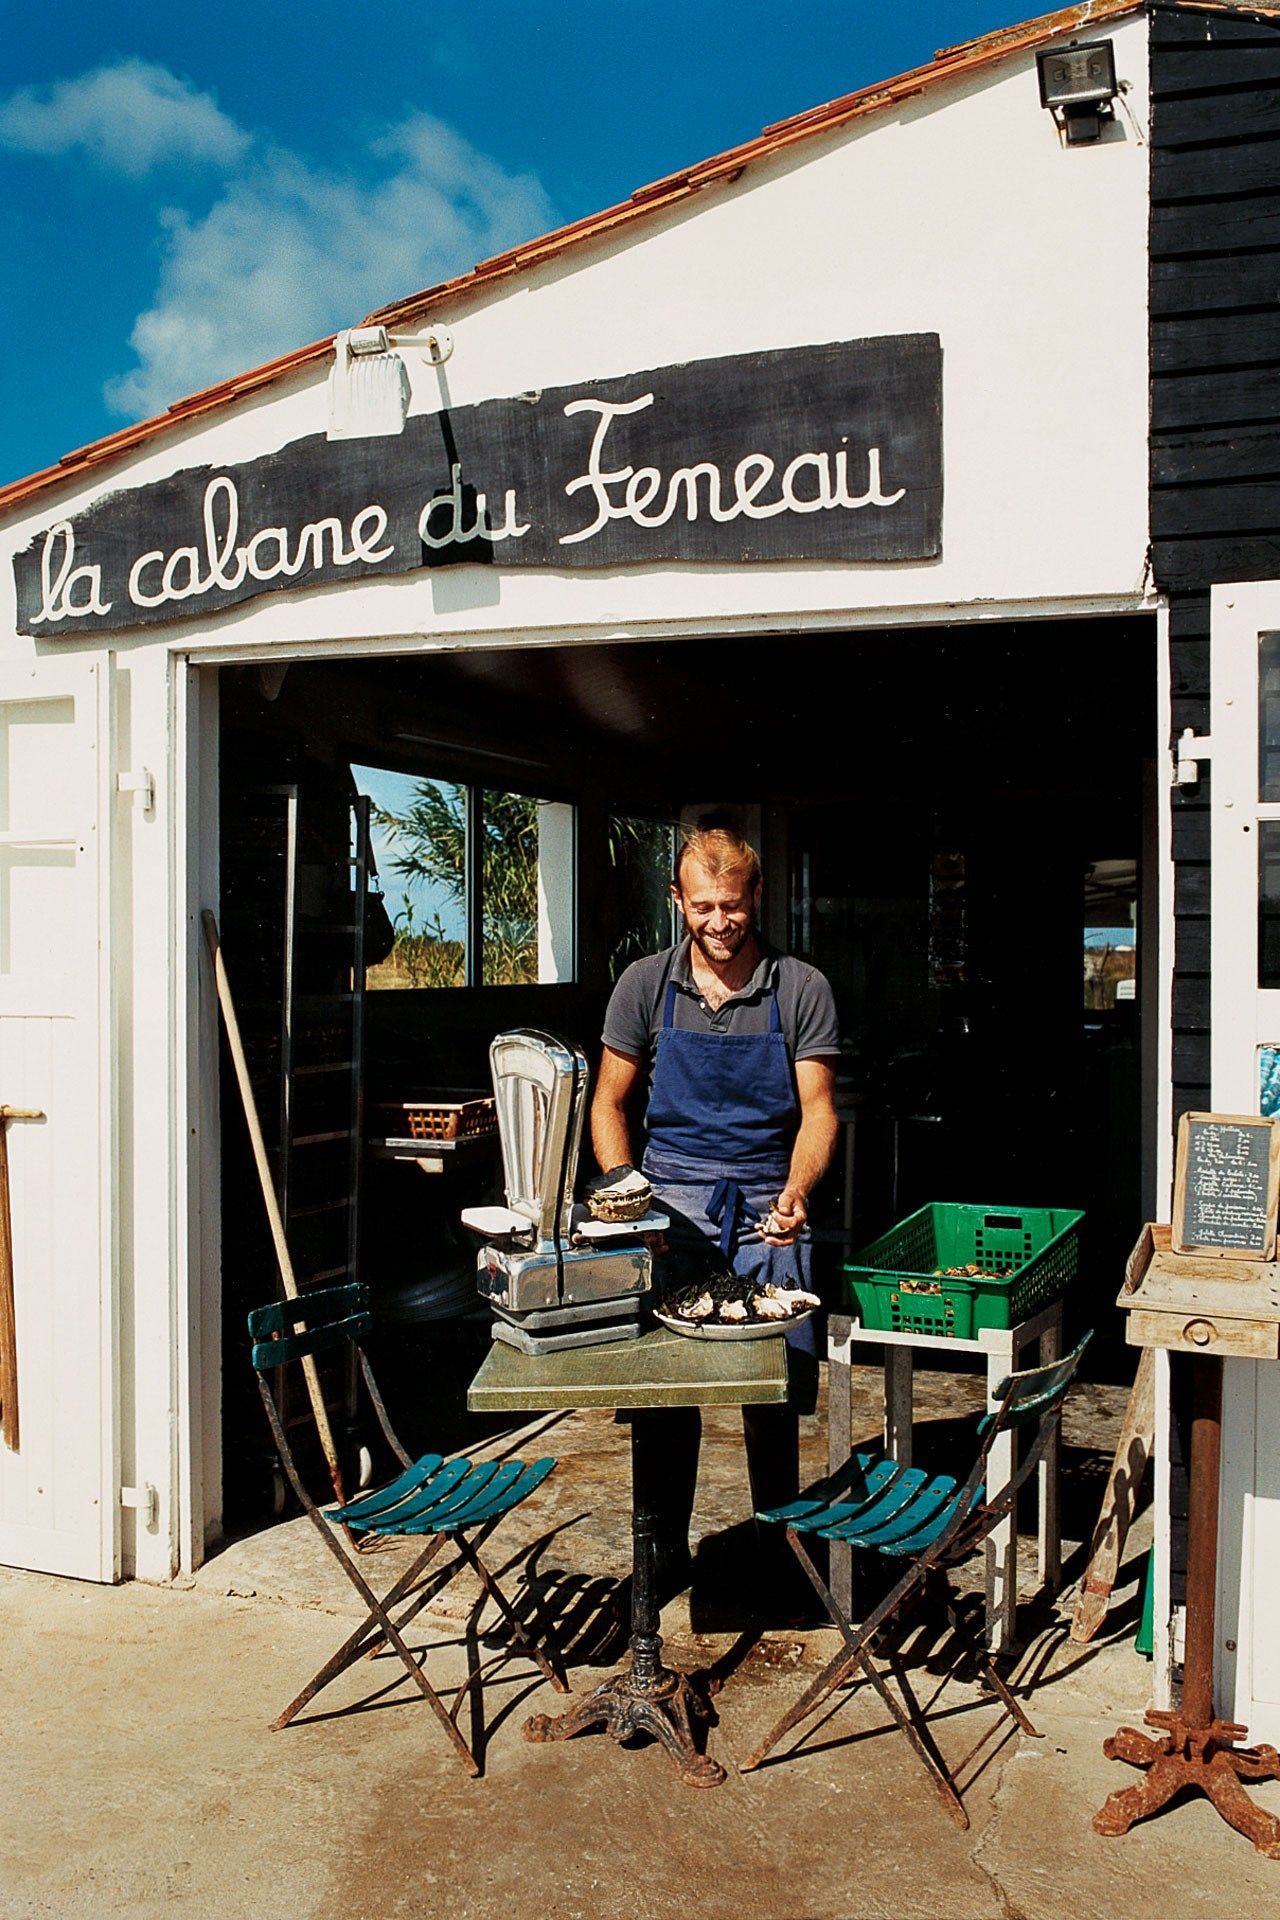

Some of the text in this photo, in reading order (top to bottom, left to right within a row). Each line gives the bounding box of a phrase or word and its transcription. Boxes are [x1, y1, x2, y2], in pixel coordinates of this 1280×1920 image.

[29, 393, 906, 624] la cabane du Feneau
